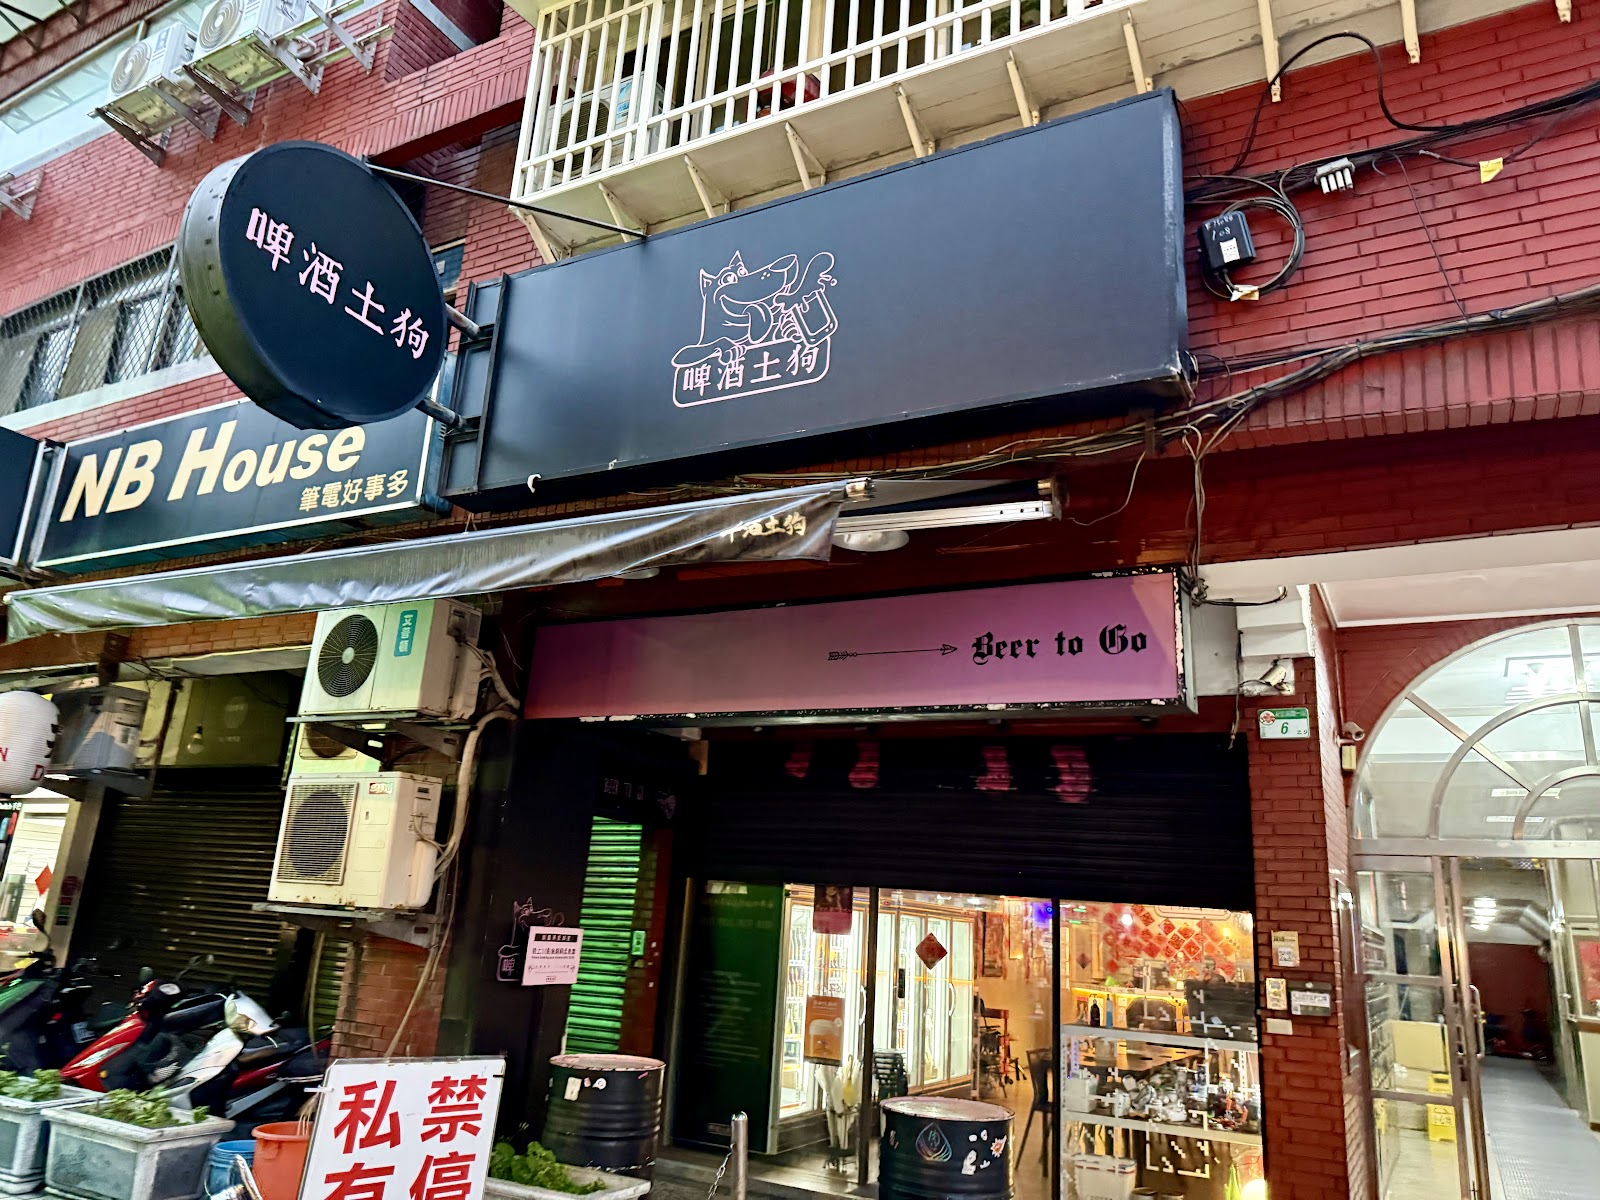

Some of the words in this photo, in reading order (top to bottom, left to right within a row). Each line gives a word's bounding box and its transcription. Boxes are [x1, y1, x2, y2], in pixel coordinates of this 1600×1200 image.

[245, 207, 430, 360] 啤酒土狗
[682, 343, 820, 397] 啤酒土狗
[59, 439, 163, 522] NB
[167, 420, 366, 500] House
[299, 469, 409, 512] 筆電好事多
[972, 631, 1040, 665] Beer
[1055, 631, 1083, 656] to
[1099, 623, 1148, 655] Go
[1281, 722, 1289, 734] 6
